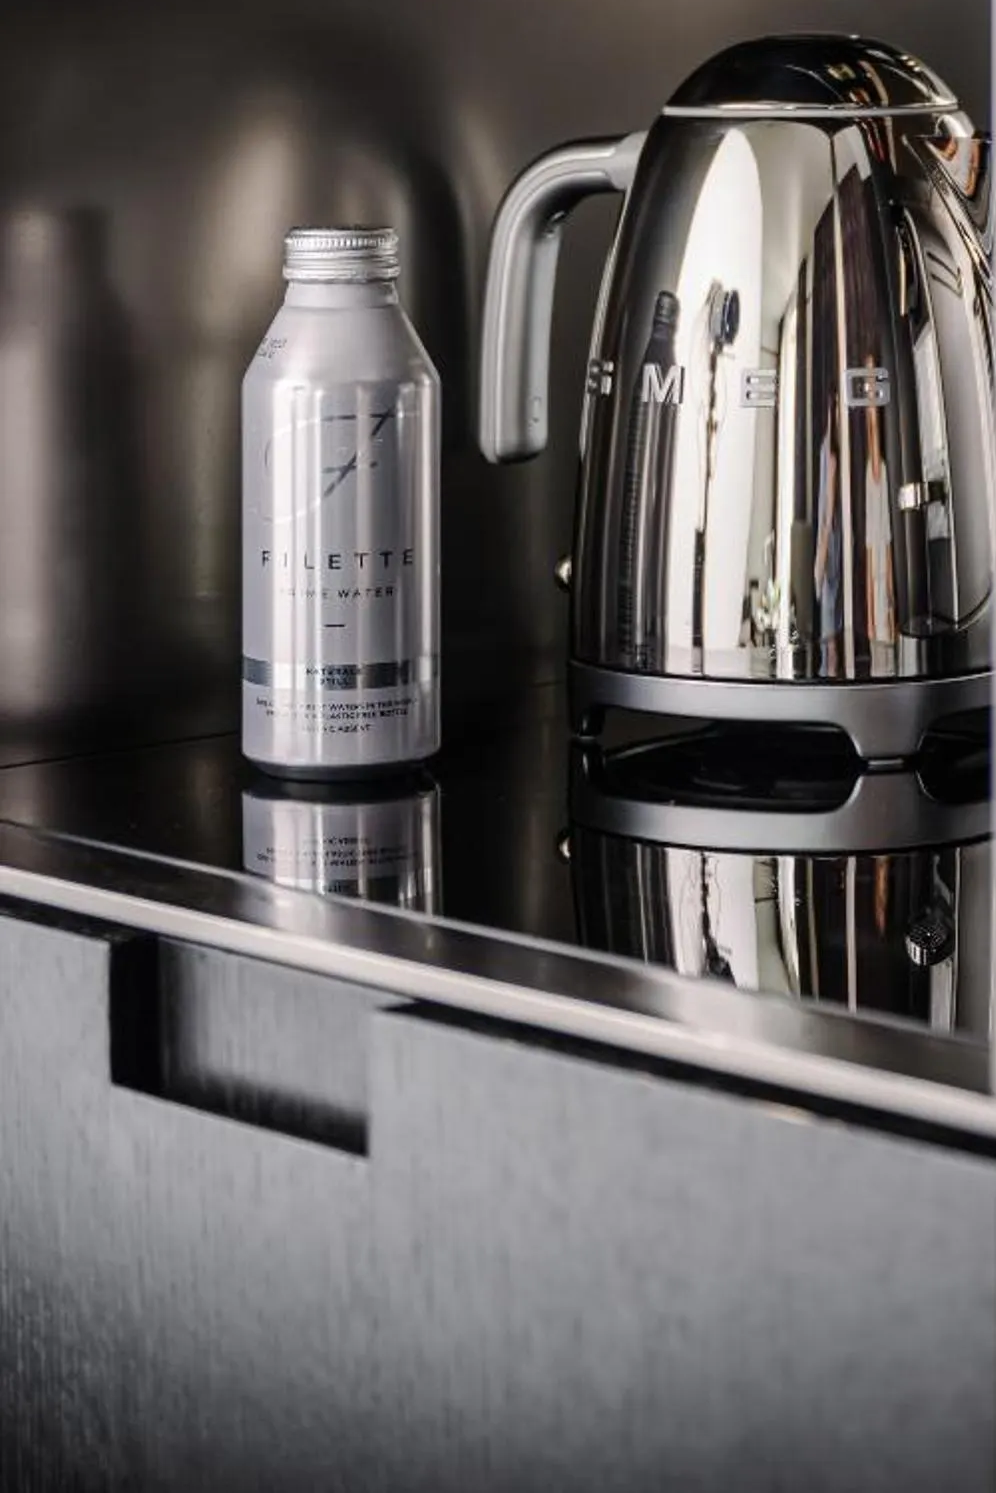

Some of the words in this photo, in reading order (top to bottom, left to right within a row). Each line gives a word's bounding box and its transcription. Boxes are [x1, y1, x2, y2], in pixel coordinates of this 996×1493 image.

[261, 549, 414, 570] FILETTE
[279, 587, 331, 600] RIME
[337, 586, 394, 599] WATER
